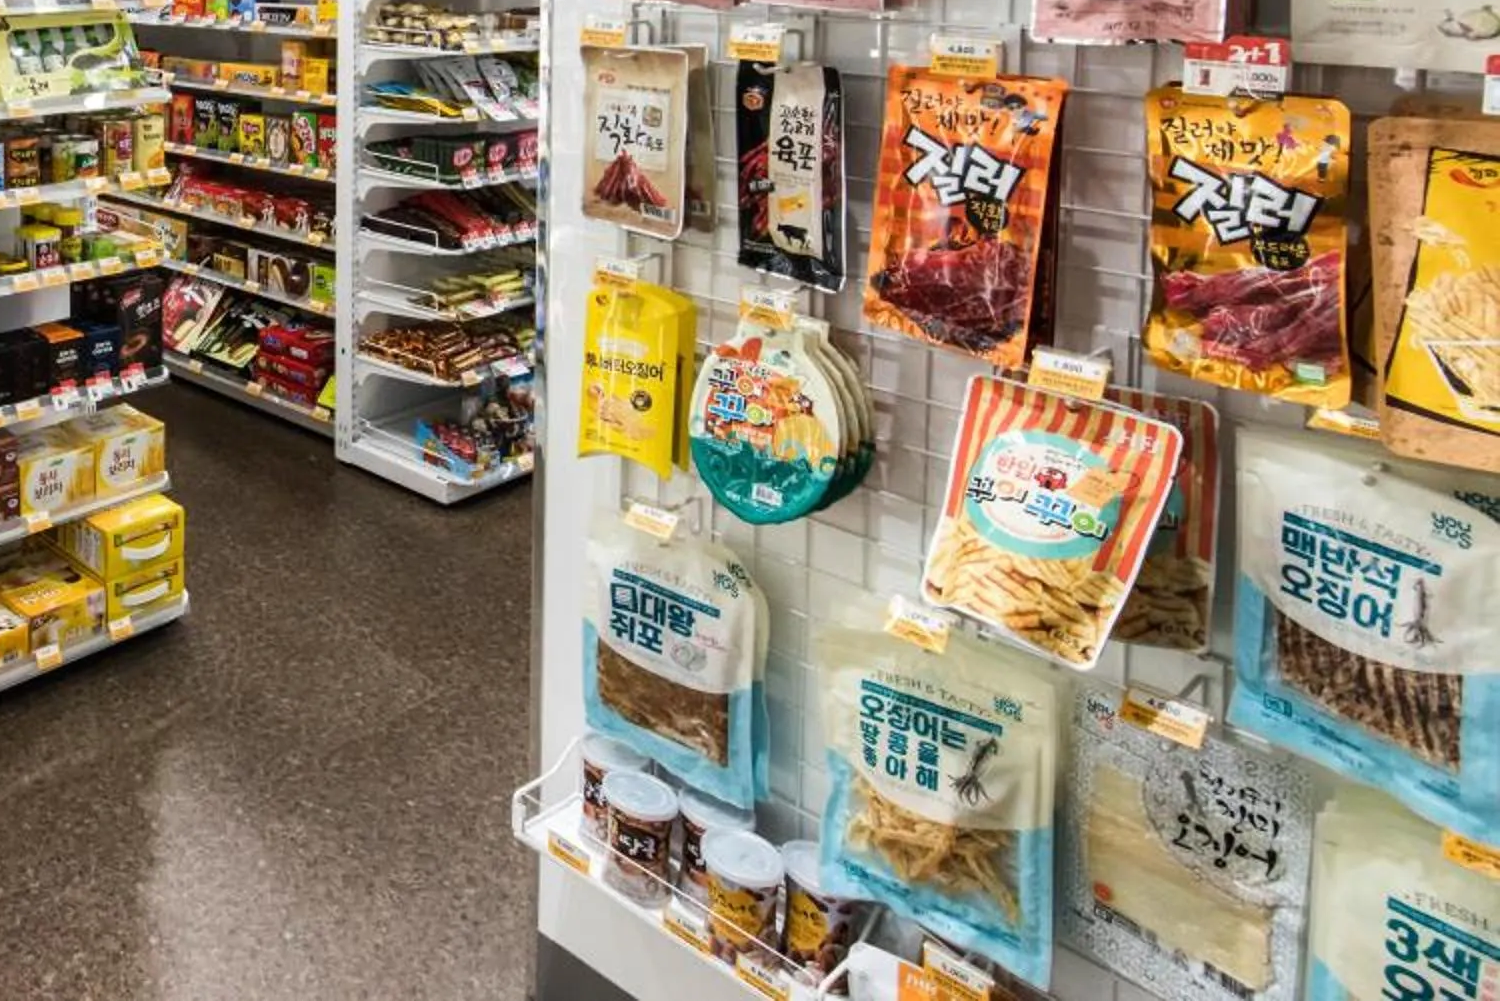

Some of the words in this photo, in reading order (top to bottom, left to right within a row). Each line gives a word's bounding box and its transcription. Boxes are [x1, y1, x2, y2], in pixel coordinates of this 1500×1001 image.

[1227, 41, 1281, 64] 2+1
[772, 135, 817, 172] 육포
[1160, 116, 1238, 146] 질러야
[904, 124, 1027, 207] 질러
[1168, 156, 1323, 246] 질러
[1281, 524, 1404, 600] 맥반석
[1280, 563, 1394, 638] 오징어
[609, 610, 663, 655] 쥐포
